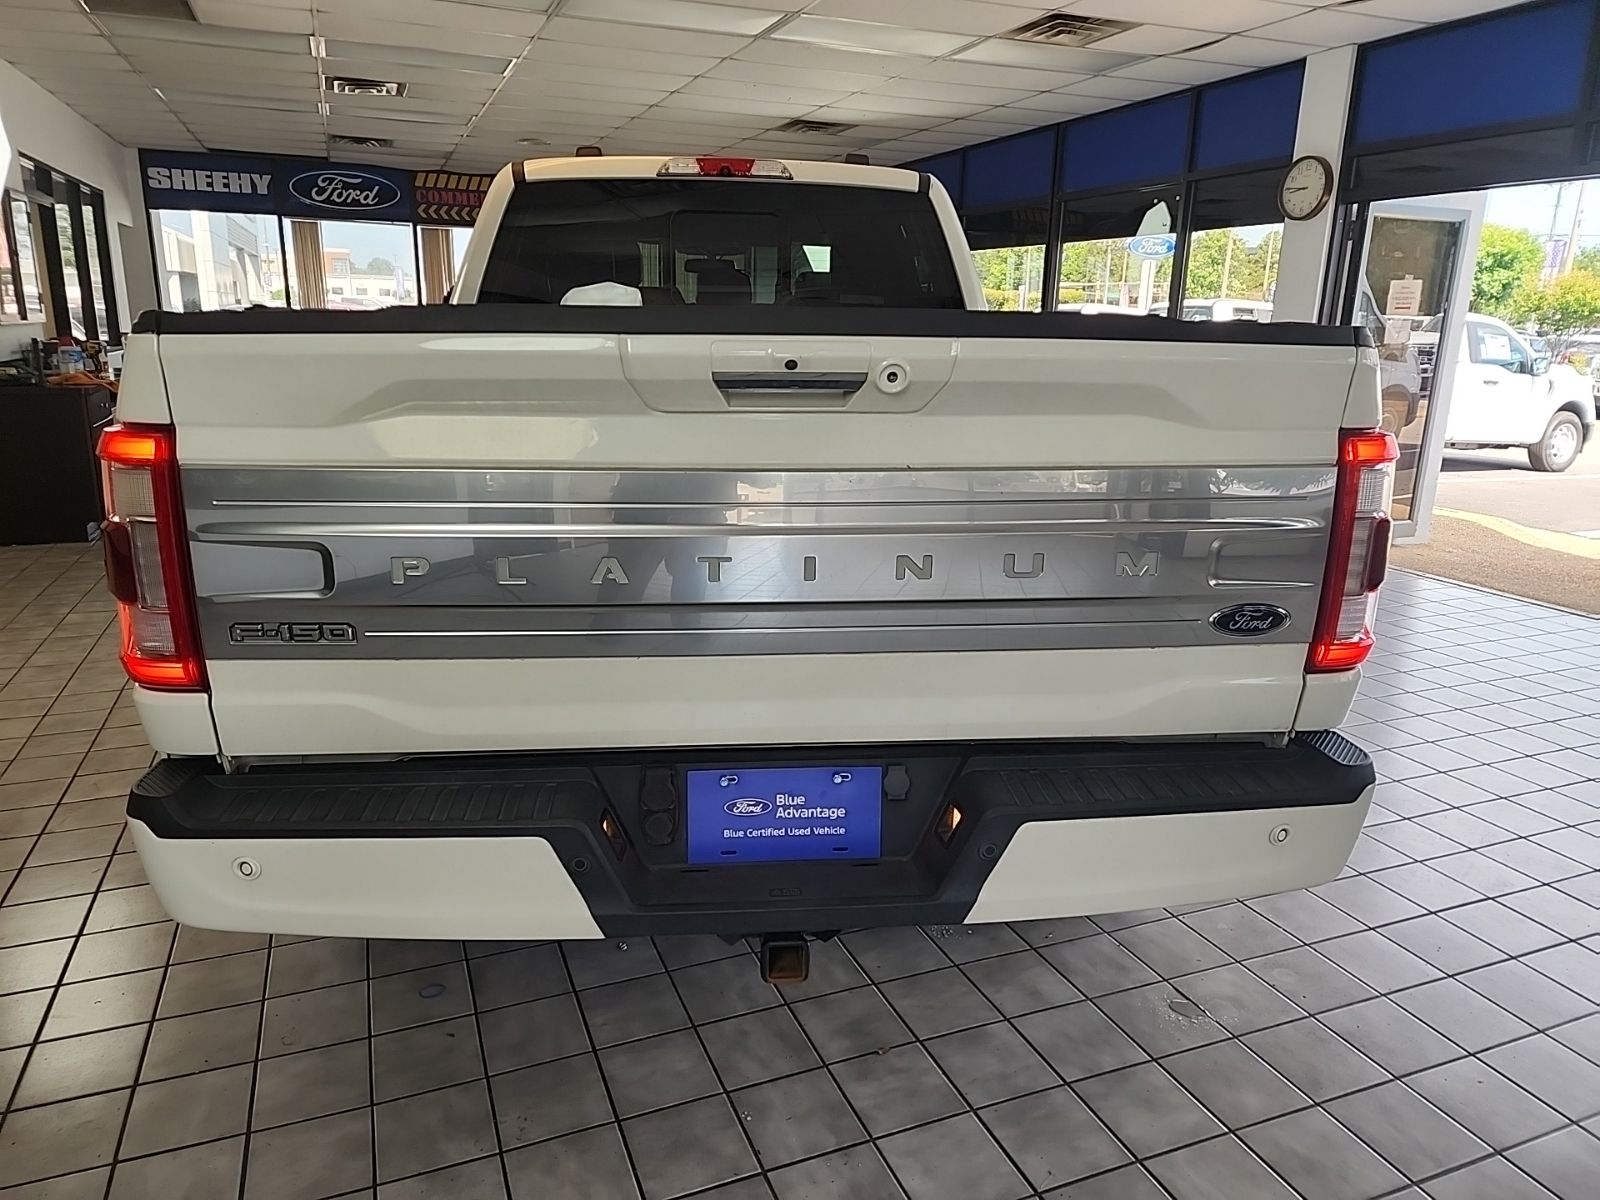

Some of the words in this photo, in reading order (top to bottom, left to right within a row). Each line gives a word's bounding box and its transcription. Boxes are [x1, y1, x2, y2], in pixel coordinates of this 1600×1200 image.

[147, 166, 272, 195] SHEEHY
[310, 174, 380, 206] Ford
[415, 189, 486, 206] COMME
[1137, 237, 1171, 254] Ford
[390, 552, 1161, 585] PLATINUM
[1228, 610, 1275, 630] Ford
[228, 622, 357, 645] F-150
[732, 801, 764, 814] Ford
[776, 794, 806, 806] Blue
[775, 807, 846, 820] Advantage
[723, 829, 745, 838] Blue
[746, 827, 786, 837] Certified
[787, 826, 811, 836] Used
[813, 825, 846, 835] Vehicle
